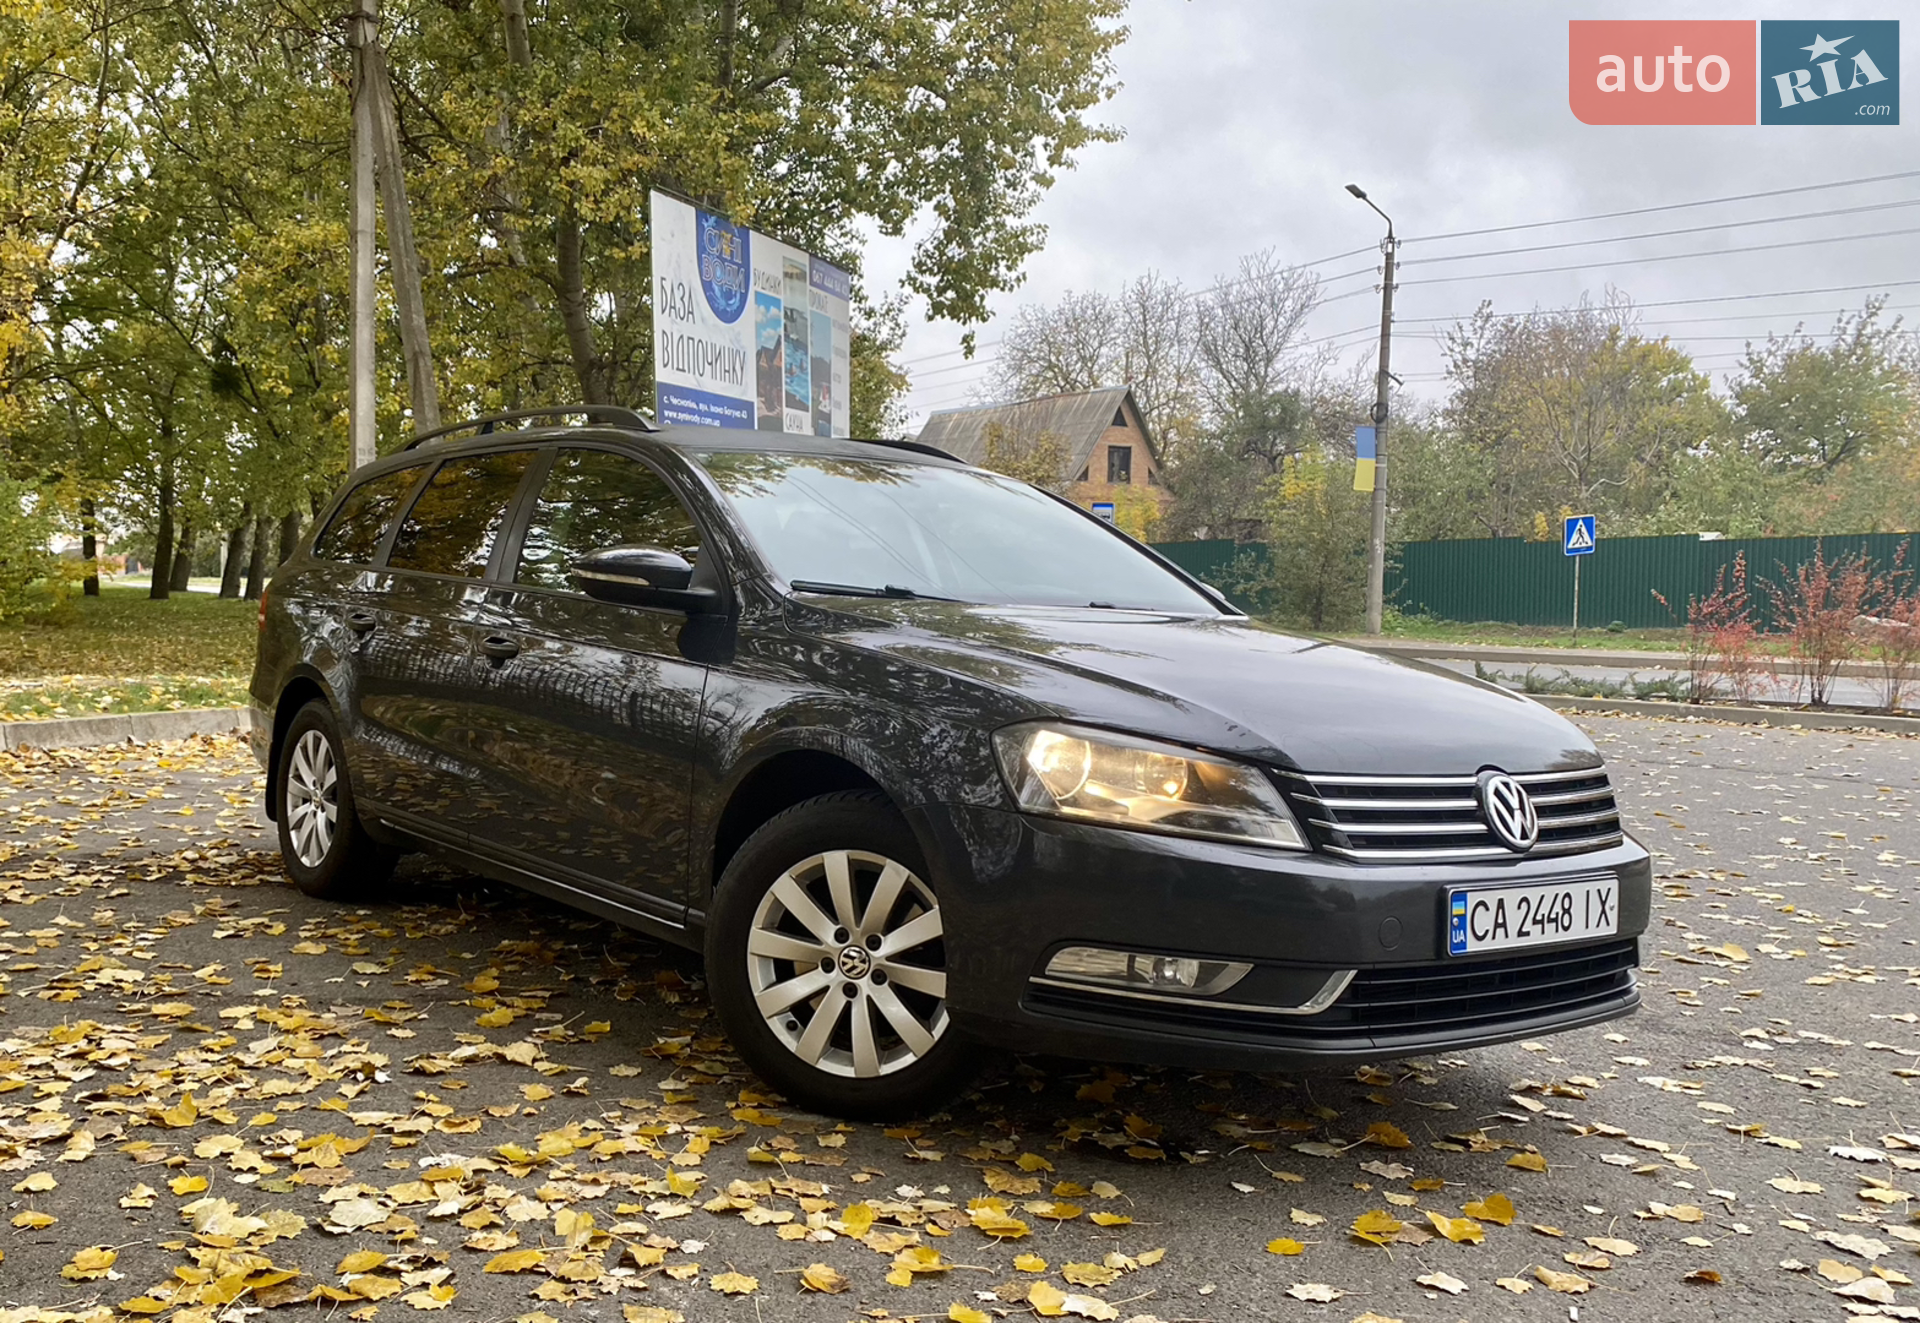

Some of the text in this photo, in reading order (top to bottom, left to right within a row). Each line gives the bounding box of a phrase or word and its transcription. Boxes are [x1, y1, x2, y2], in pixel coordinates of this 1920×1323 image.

[702, 253, 746, 293] ВОДИ
[660, 276, 696, 325] БАЗА
[662, 330, 746, 387] ВІДПОЧИНКУ
[1452, 929, 1466, 944] UA
[1470, 897, 1509, 942] CA
[1516, 891, 1573, 938] 2448
